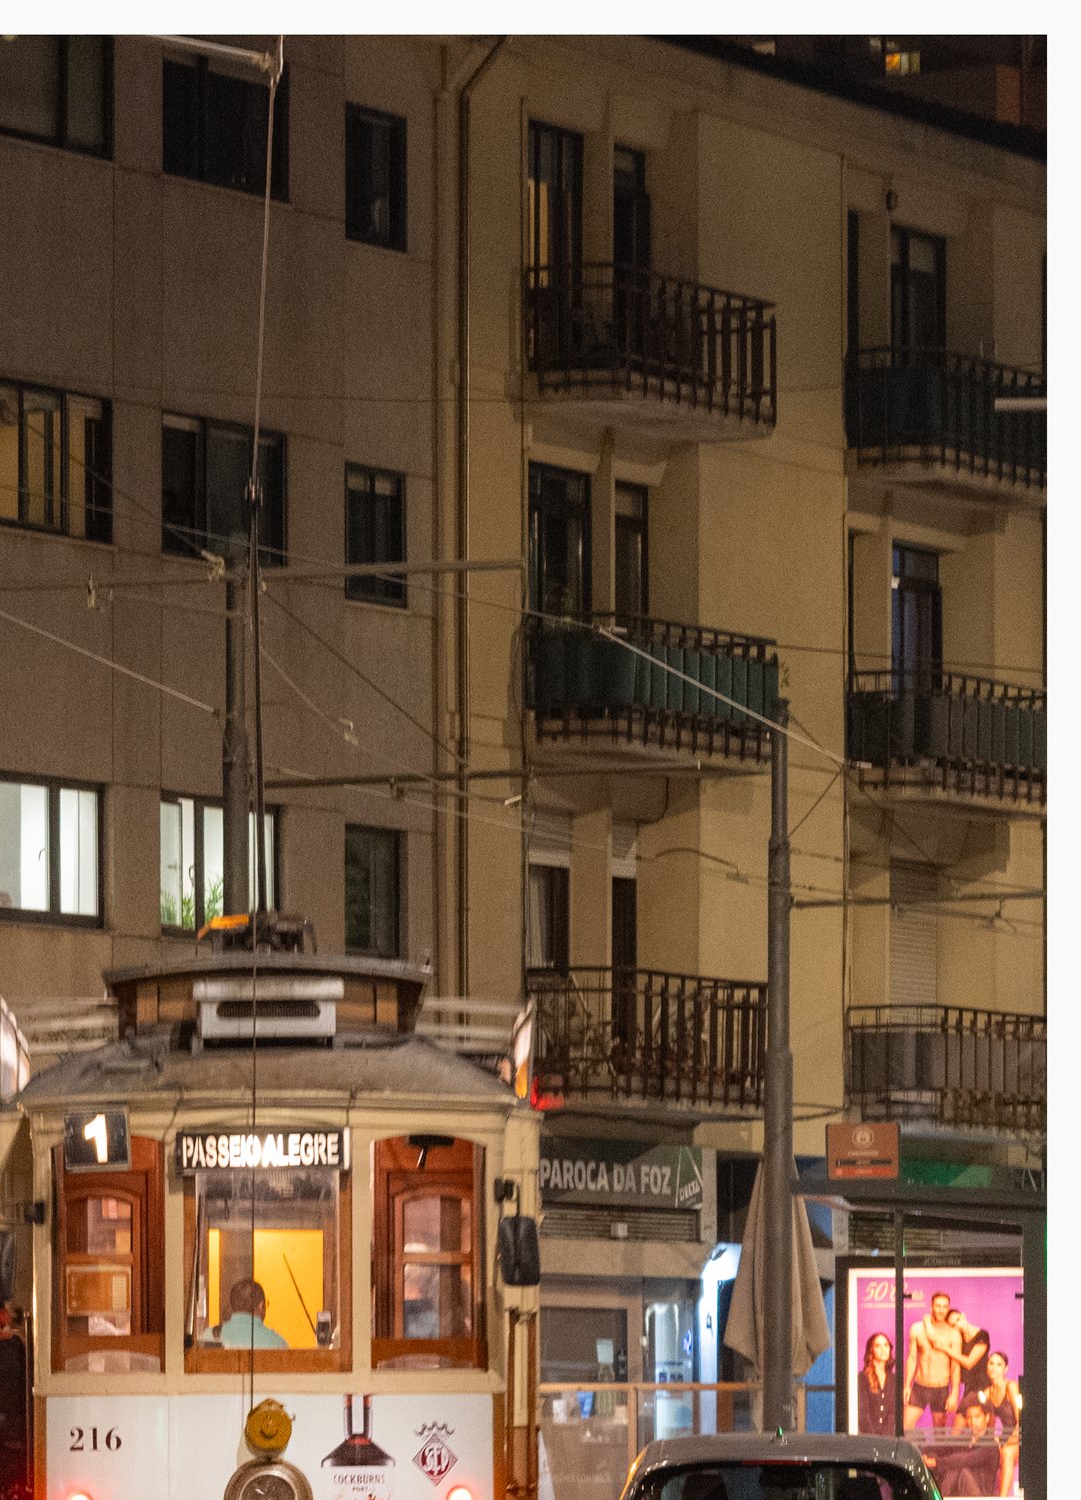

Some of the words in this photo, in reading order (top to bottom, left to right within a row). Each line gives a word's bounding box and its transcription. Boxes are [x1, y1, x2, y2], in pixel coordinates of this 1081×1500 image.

[84, 1113, 108, 1164] 1
[182, 1134, 261, 1168] PASSEIO
[262, 1133, 340, 1168] ALEGRE
[613, 1163, 637, 1194] DA
[640, 1164, 672, 1195] FOZ
[70, 1427, 122, 1451] 216
